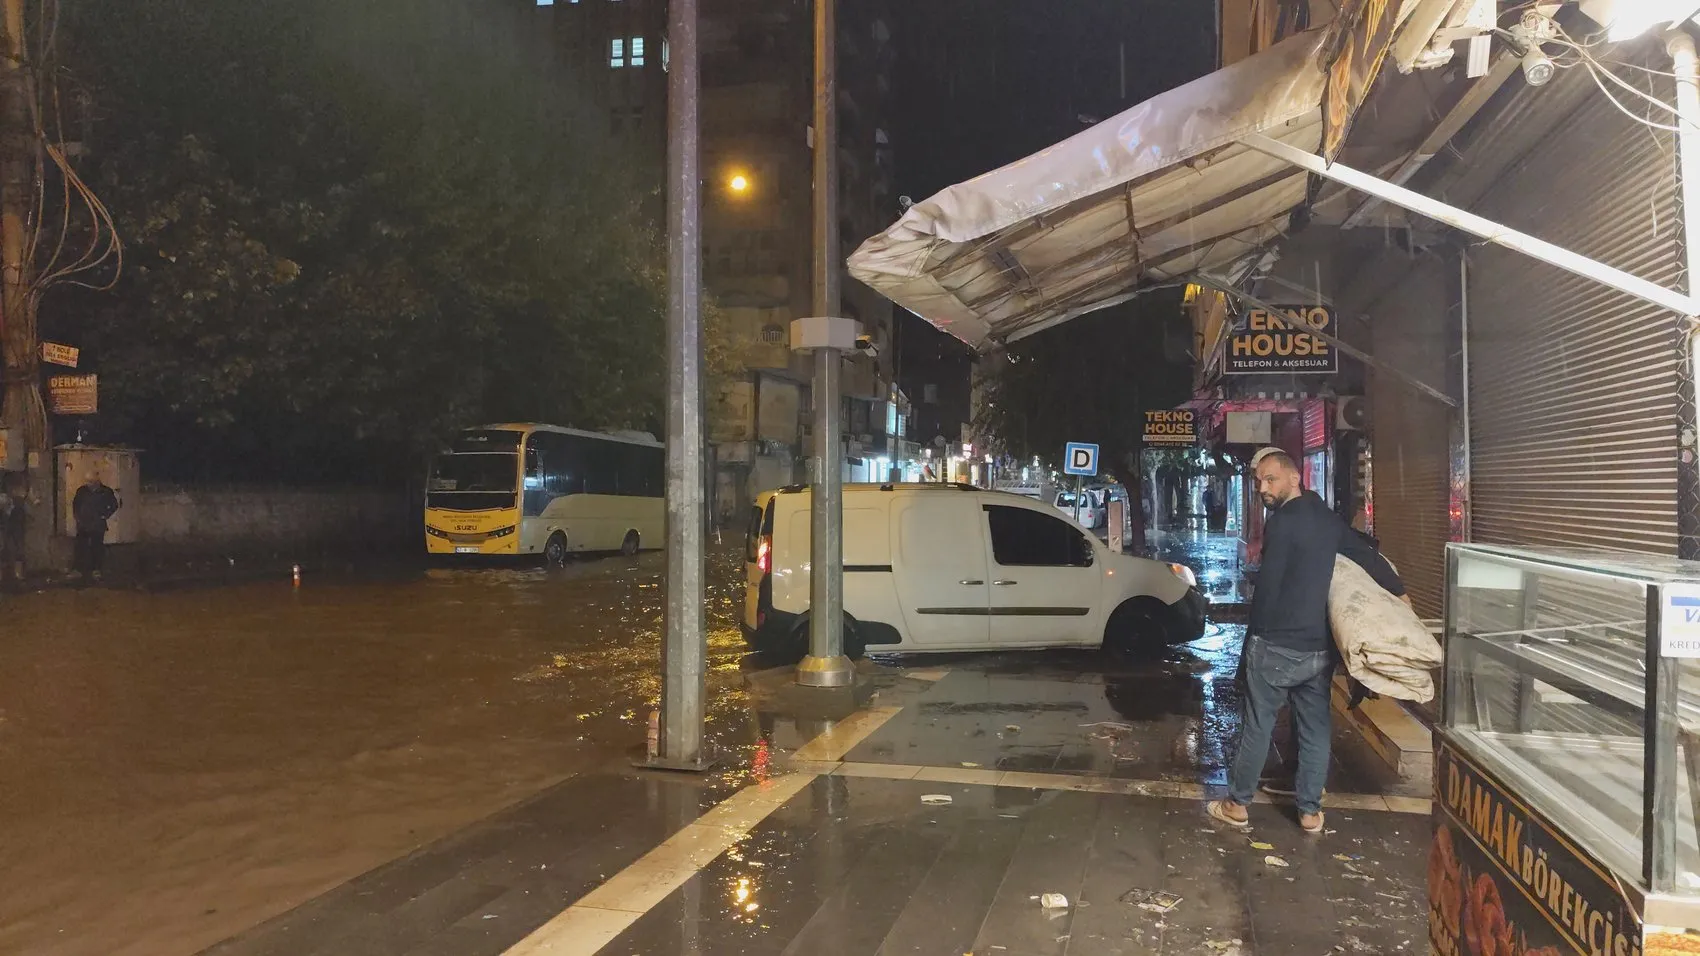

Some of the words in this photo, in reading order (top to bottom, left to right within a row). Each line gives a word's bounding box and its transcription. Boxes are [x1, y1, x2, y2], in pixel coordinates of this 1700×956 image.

[1232, 333, 1329, 357] HOUSE
[1282, 360, 1329, 368] AKSESUAR
[1144, 411, 1195, 422] TEKNO
[1145, 423, 1194, 434] HOUSE
[1073, 449, 1090, 467] D
[1448, 761, 1524, 877] DAMAK
